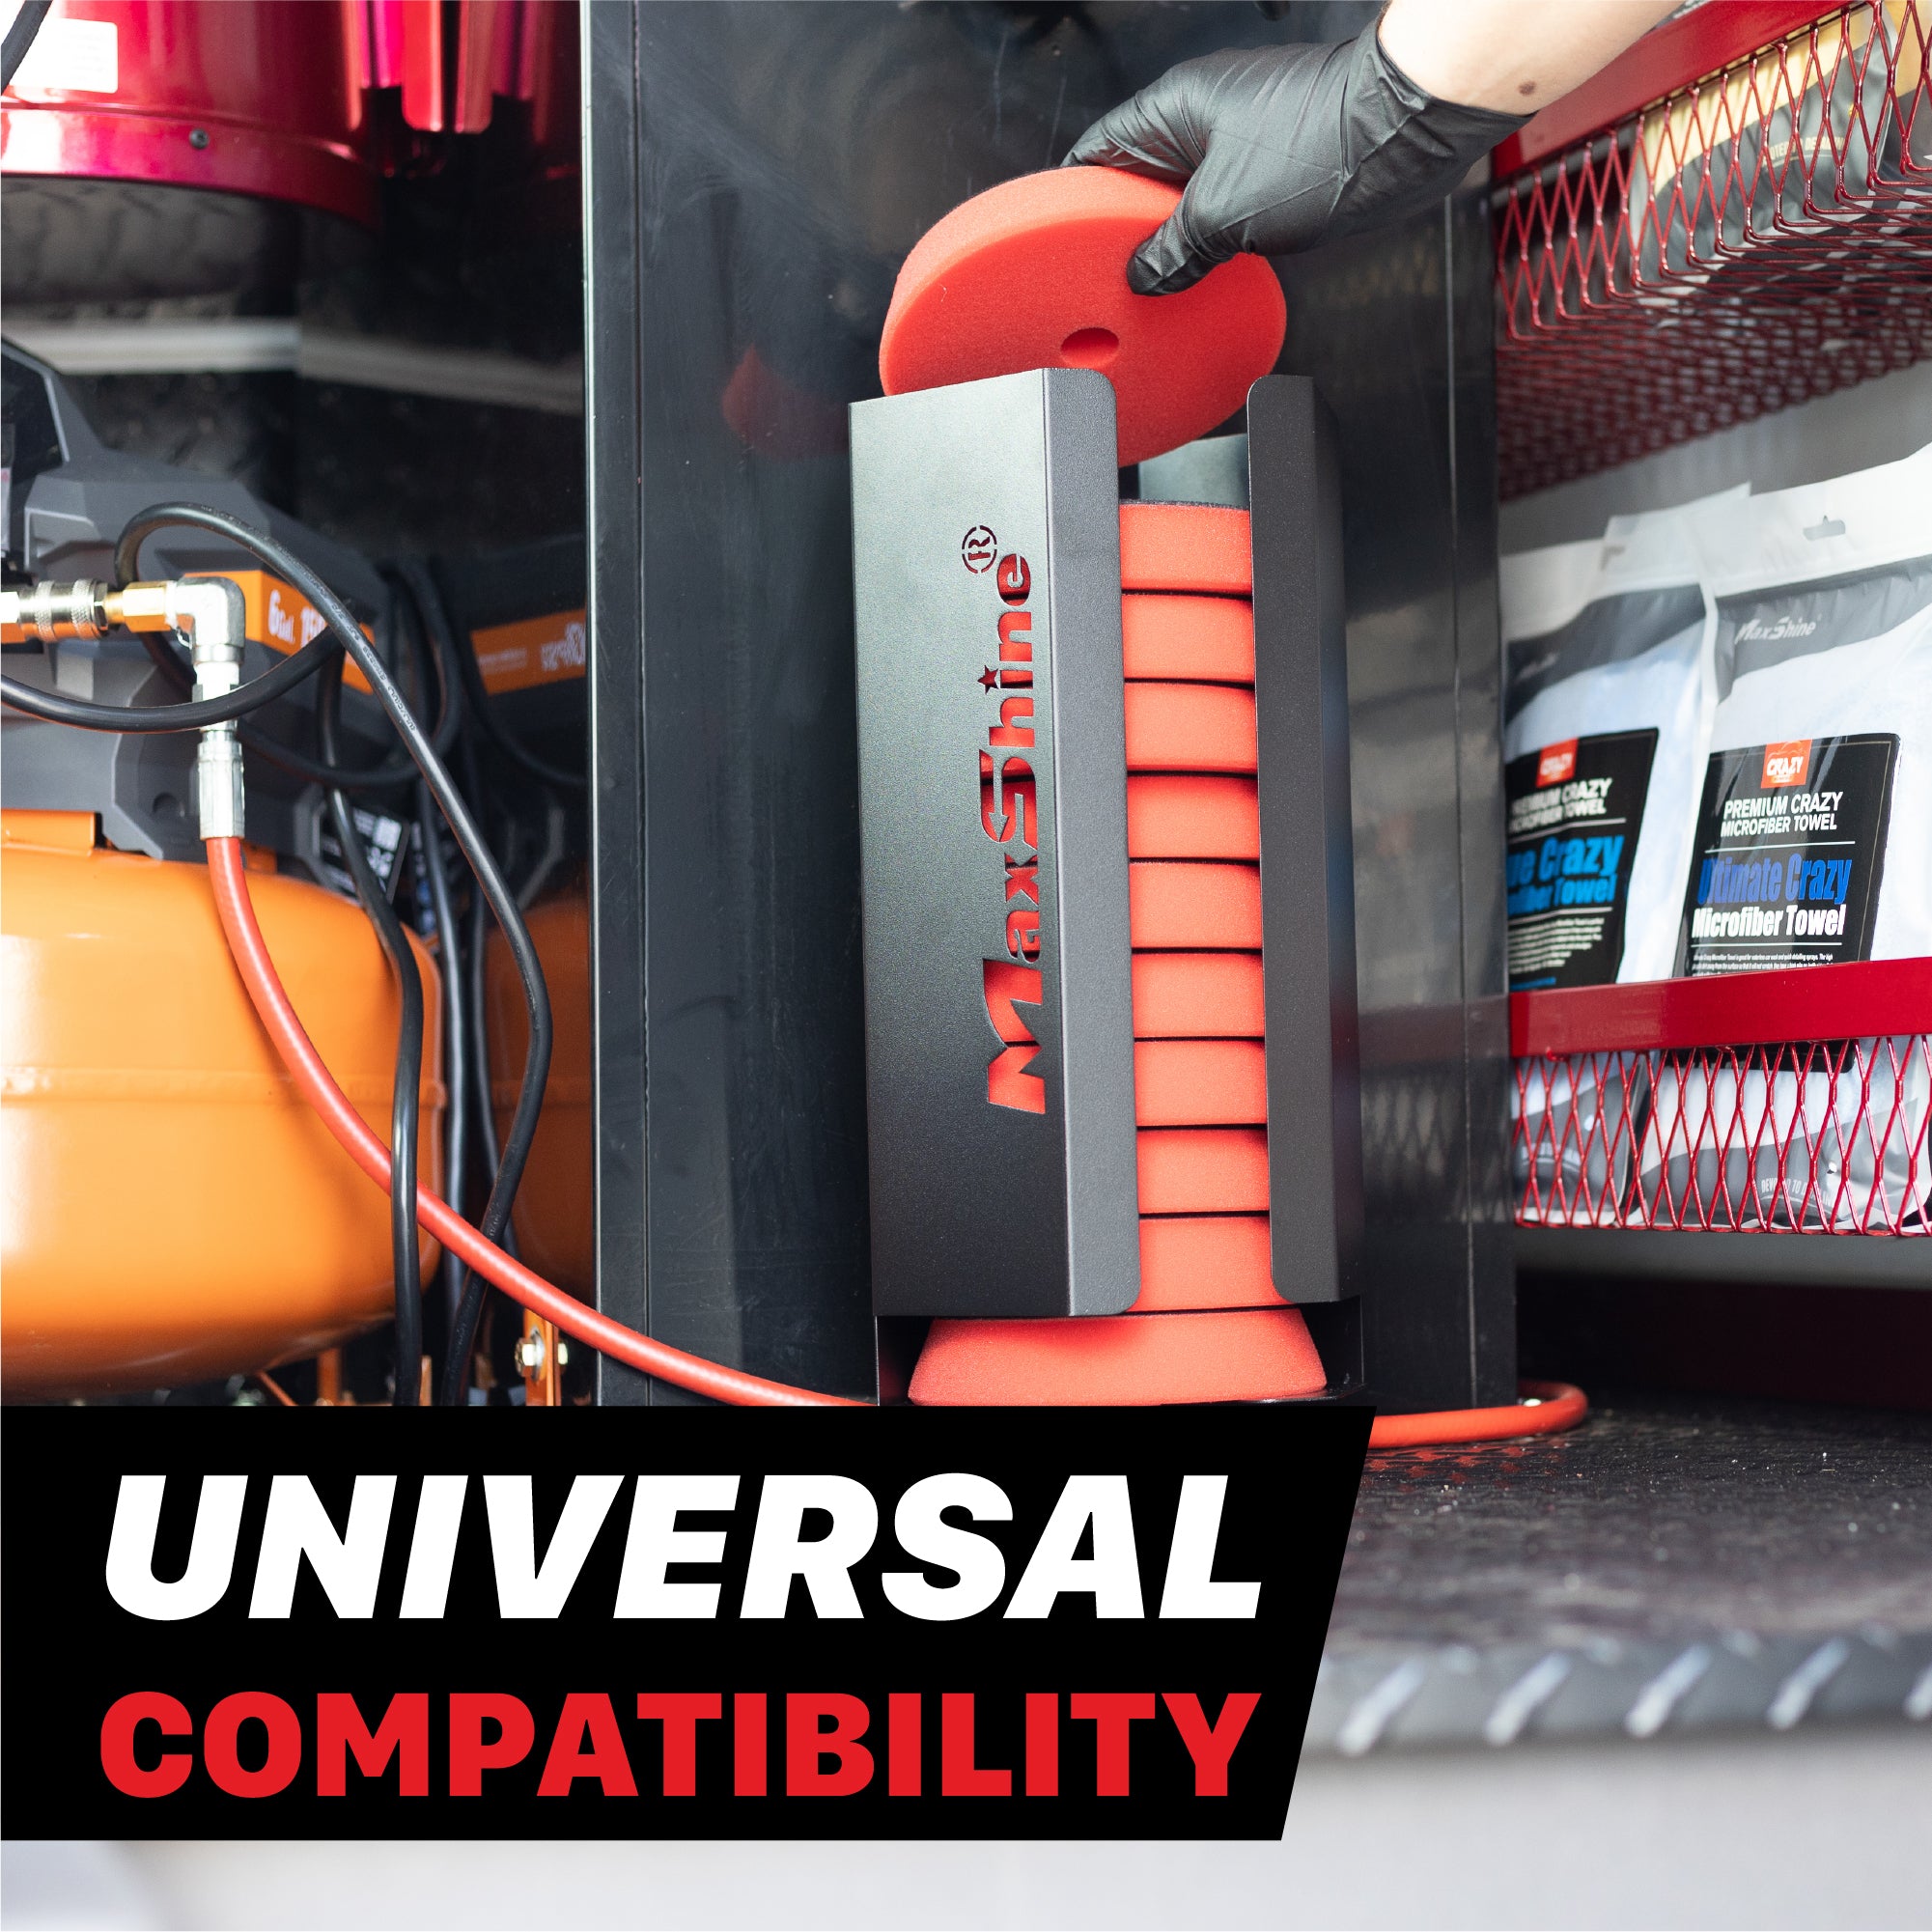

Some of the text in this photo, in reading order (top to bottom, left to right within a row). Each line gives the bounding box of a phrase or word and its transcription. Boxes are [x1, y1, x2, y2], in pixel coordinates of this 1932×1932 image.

[1734, 615, 1817, 644] MaxShine
[1767, 756, 1804, 776] CRAZY
[1562, 776, 1613, 804] CRAZY
[1563, 798, 1608, 818] TOWEL
[1723, 791, 1844, 820] PREMIUM CRAZY
[1720, 813, 1838, 838] MICROFIBER TOWEL
[1538, 835, 1625, 882] Crazy
[1554, 872, 1618, 907] Towel
[1696, 852, 1853, 906] Ultimate Crazy
[1691, 904, 1846, 938] Microfiber Towel
